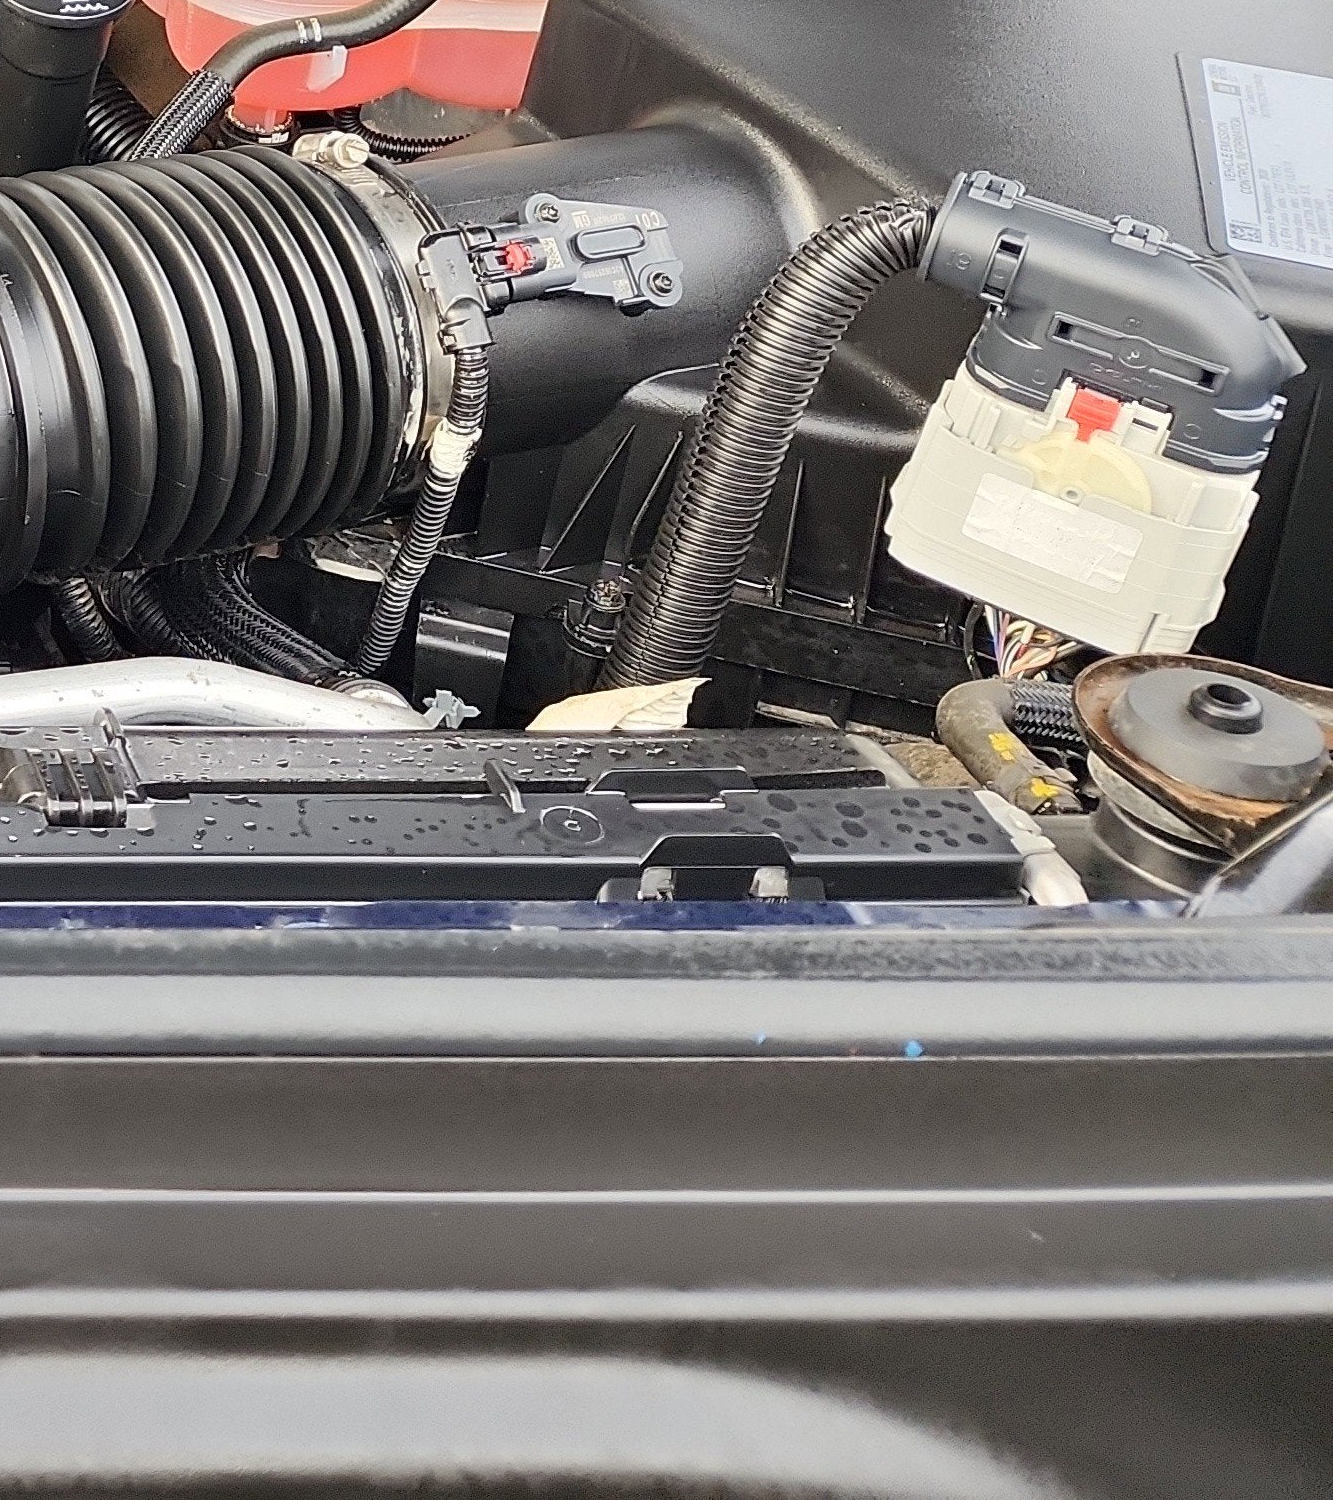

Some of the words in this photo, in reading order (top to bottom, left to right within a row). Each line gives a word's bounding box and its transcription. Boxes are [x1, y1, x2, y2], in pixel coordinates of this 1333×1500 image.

[1216, 120, 1233, 152] EMISSION
[1229, 115, 1248, 160] INFORMATION
[1221, 152, 1236, 183] VEHICLE
[1236, 162, 1253, 195] CONTROL
[572, 211, 591, 229] GM
